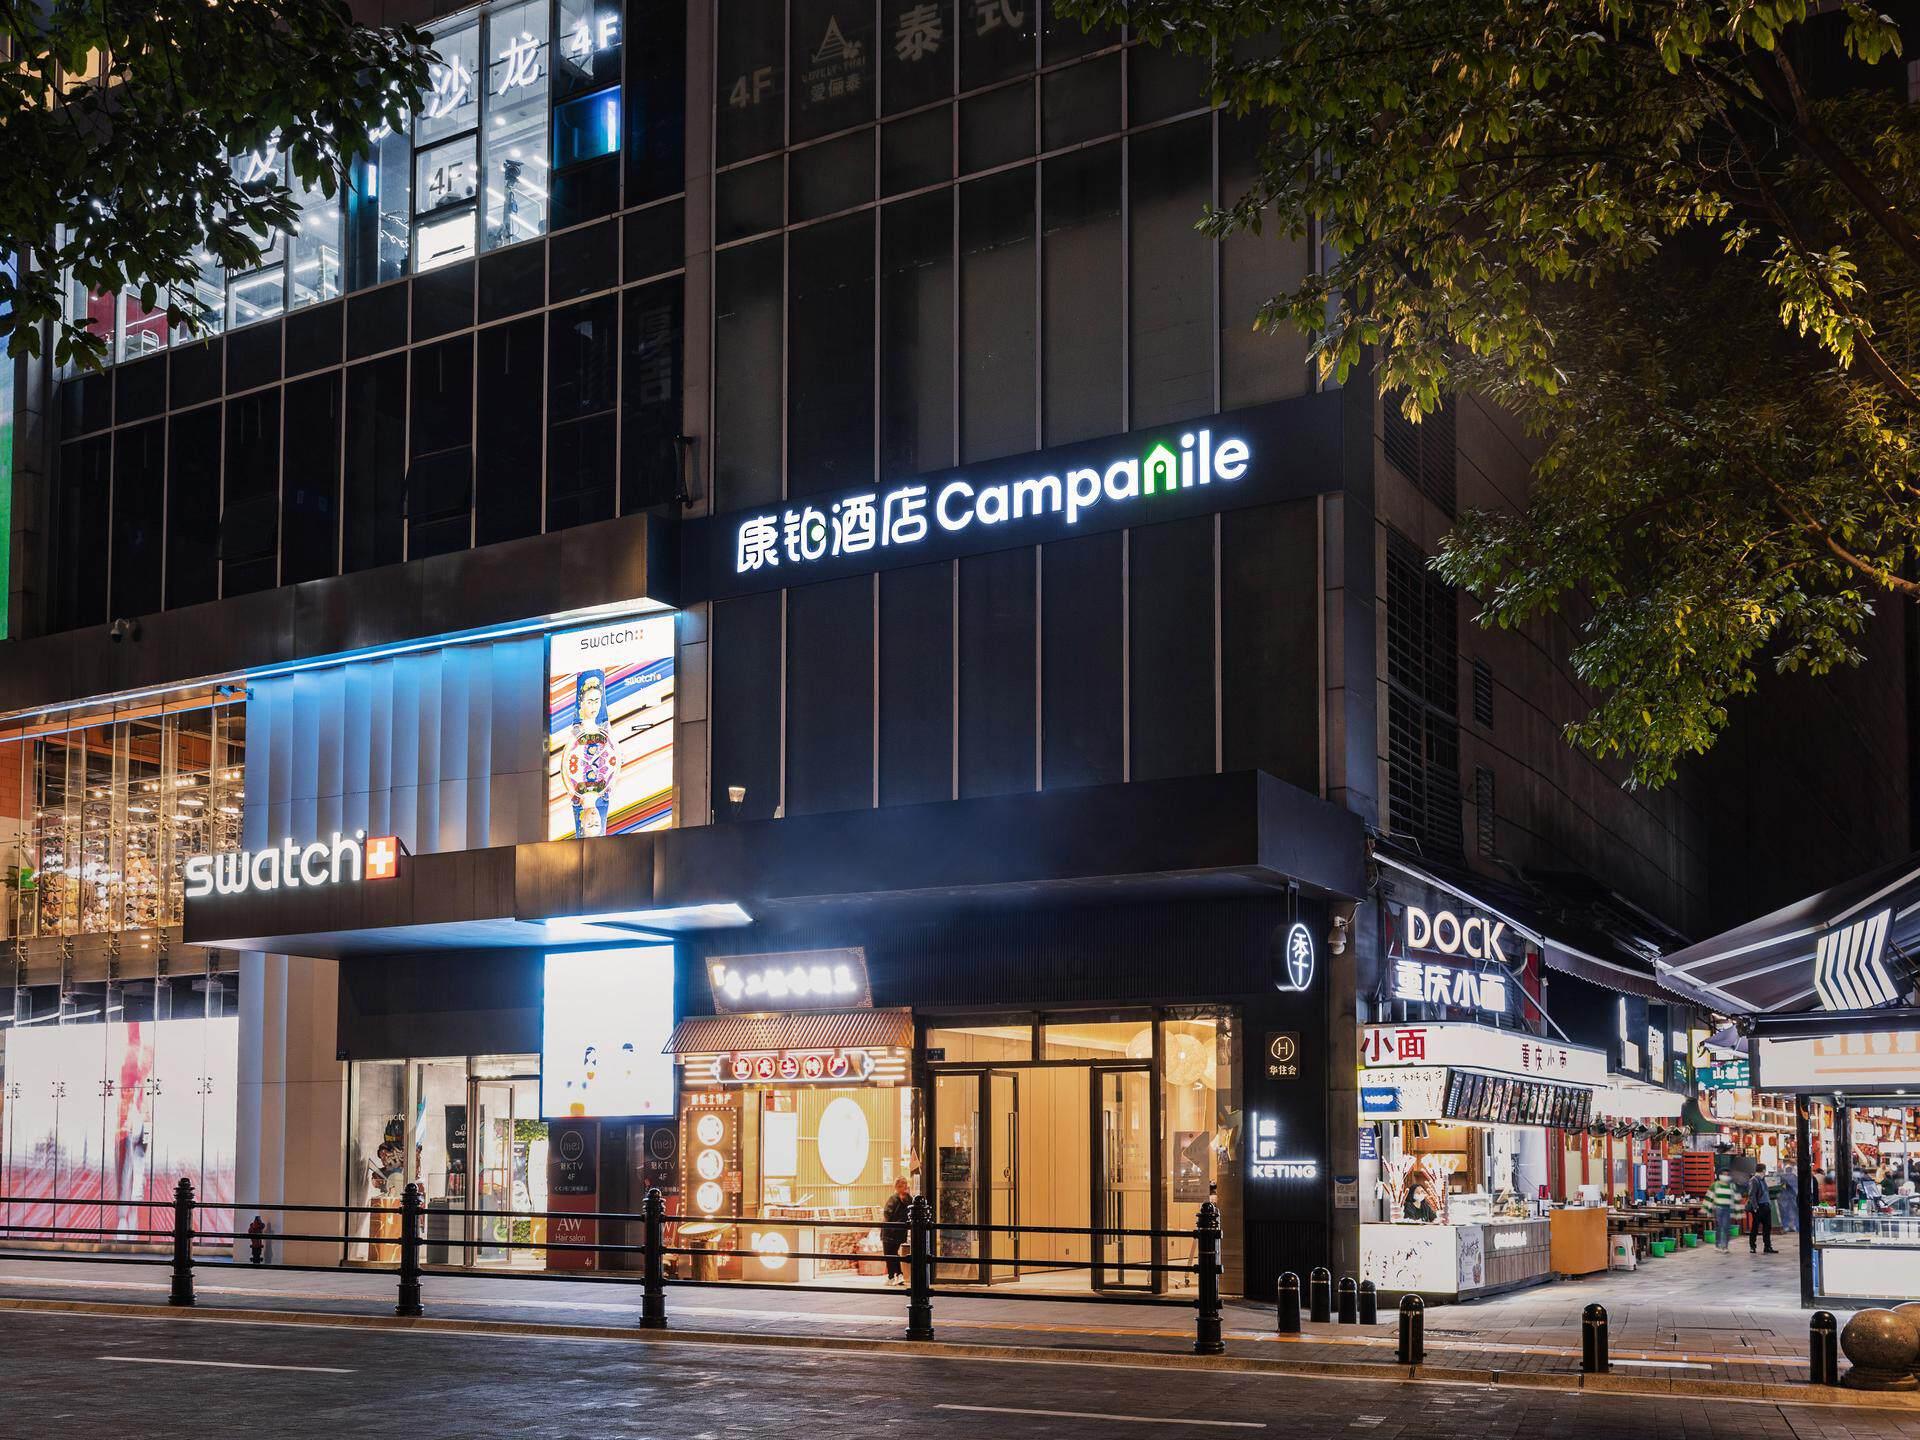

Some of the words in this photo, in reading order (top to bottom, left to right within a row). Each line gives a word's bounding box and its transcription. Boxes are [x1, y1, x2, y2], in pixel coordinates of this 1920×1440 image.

[571, 15, 619, 54] 4F
[728, 65, 774, 108] 4F
[429, 161, 465, 195] 4F
[736, 485, 929, 574] 康铂酒店
[935, 429, 1250, 532] Campanile
[580, 628, 634, 650] swatch
[186, 831, 361, 897] swatch
[1406, 905, 1507, 962] DOCK
[1395, 960, 1506, 1013] 重庆小面
[1360, 1028, 1428, 1062] 小面
[1269, 1065, 1297, 1076] 华住会
[1252, 1165, 1316, 1178] KETING
[555, 1234, 568, 1242] Hair
[569, 1234, 586, 1243] salon
[557, 1218, 582, 1231] AW
